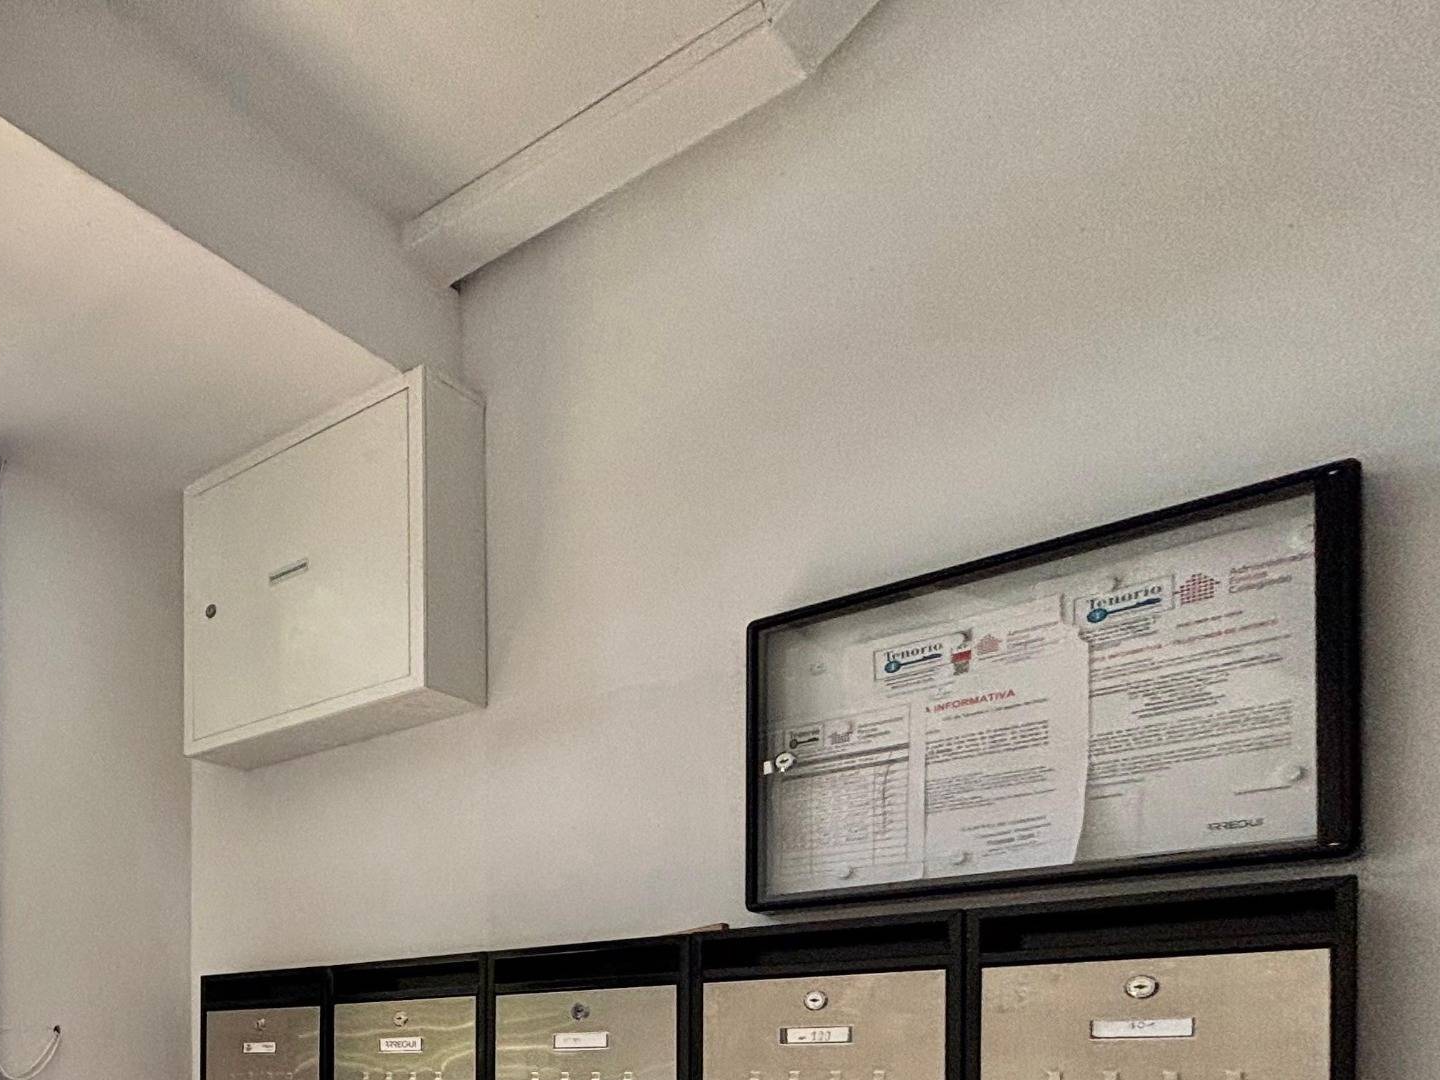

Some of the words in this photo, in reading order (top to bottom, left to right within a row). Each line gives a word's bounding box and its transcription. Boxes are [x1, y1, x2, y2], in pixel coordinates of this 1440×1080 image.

[1086, 585, 1162, 610] Tenorio
[883, 642, 944, 662] Tenorio
[933, 688, 1016, 713] INFORMATIVA
